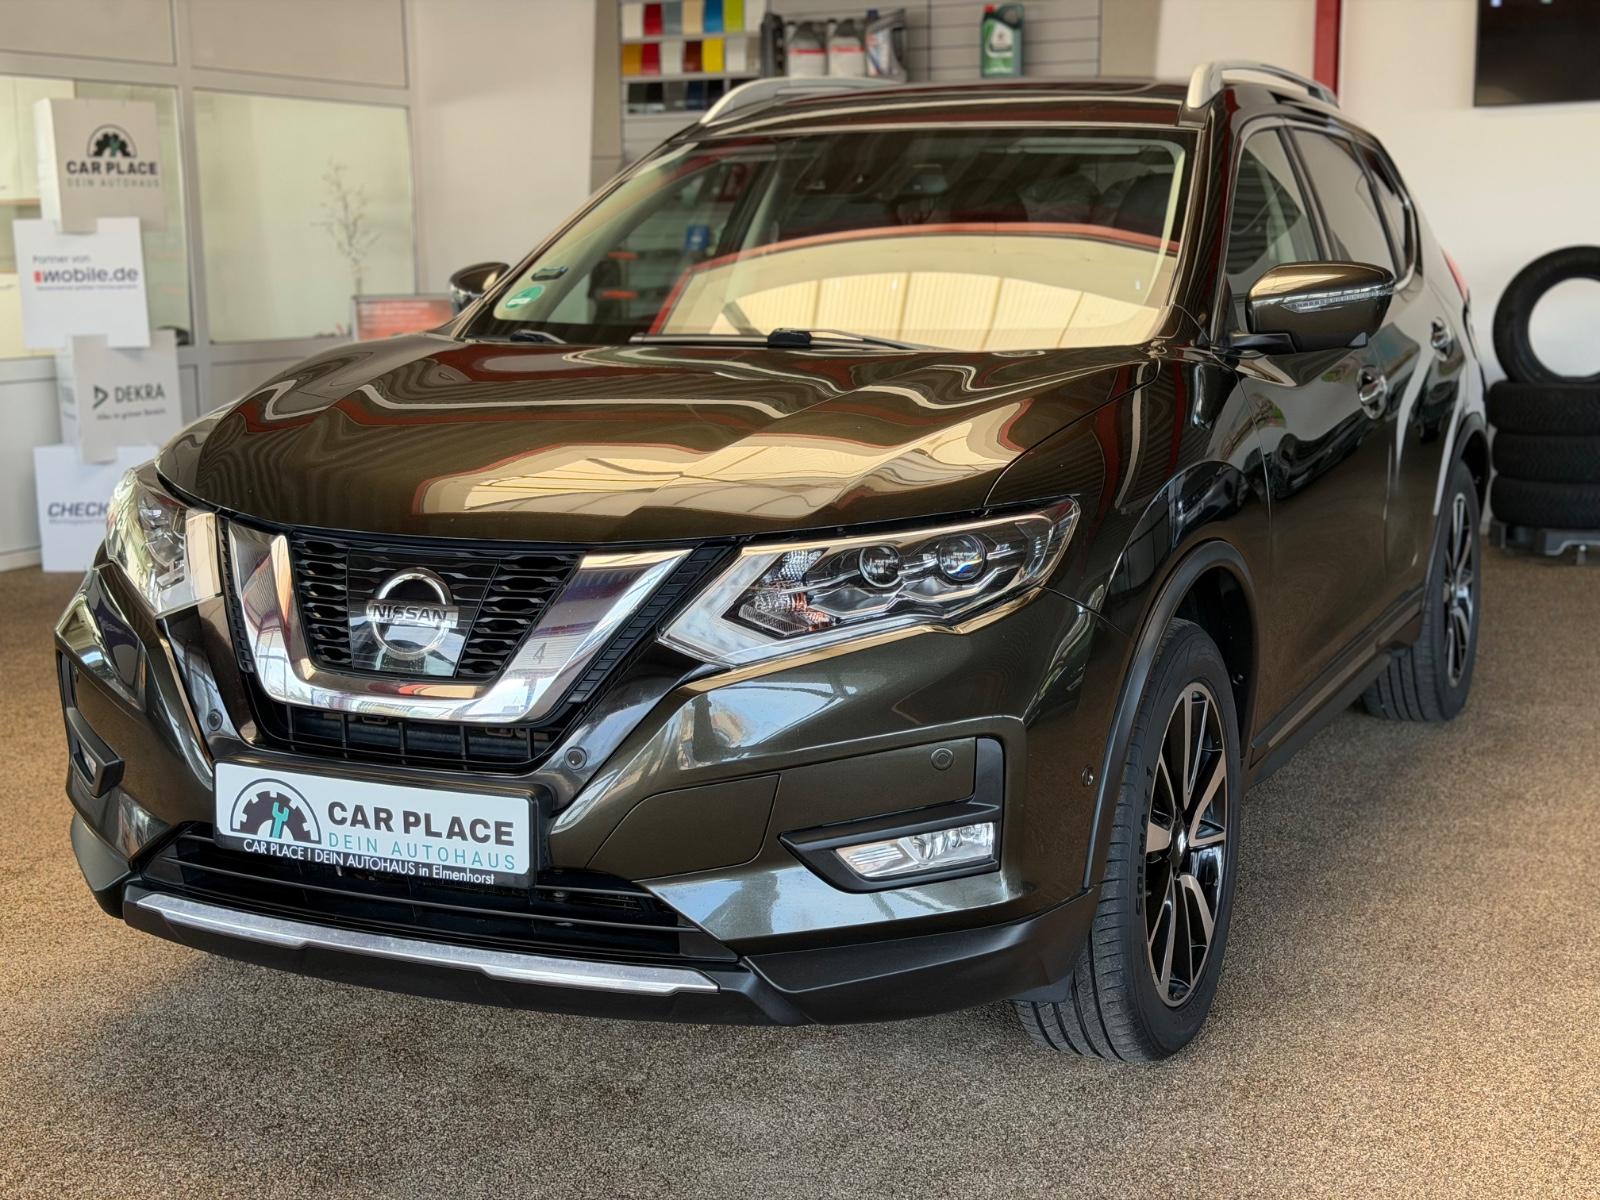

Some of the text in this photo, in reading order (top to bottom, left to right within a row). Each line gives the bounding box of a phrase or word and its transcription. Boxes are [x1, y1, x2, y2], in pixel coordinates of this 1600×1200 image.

[66, 161, 158, 175] CAR PLACE
[43, 266, 139, 283] mobile.de
[114, 382, 166, 403] DEKRA
[373, 604, 447, 621] NISSAN
[327, 801, 515, 847] CAR PLACE
[329, 832, 515, 870] DEIN AUTOHAUS
[243, 839, 267, 855] CAR
[270, 843, 305, 861] PLACE
[315, 851, 343, 866] DEIN
[346, 855, 416, 876] AUTOHAUS
[419, 863, 429, 877] in
[432, 865, 495, 885] Elmenhorst
